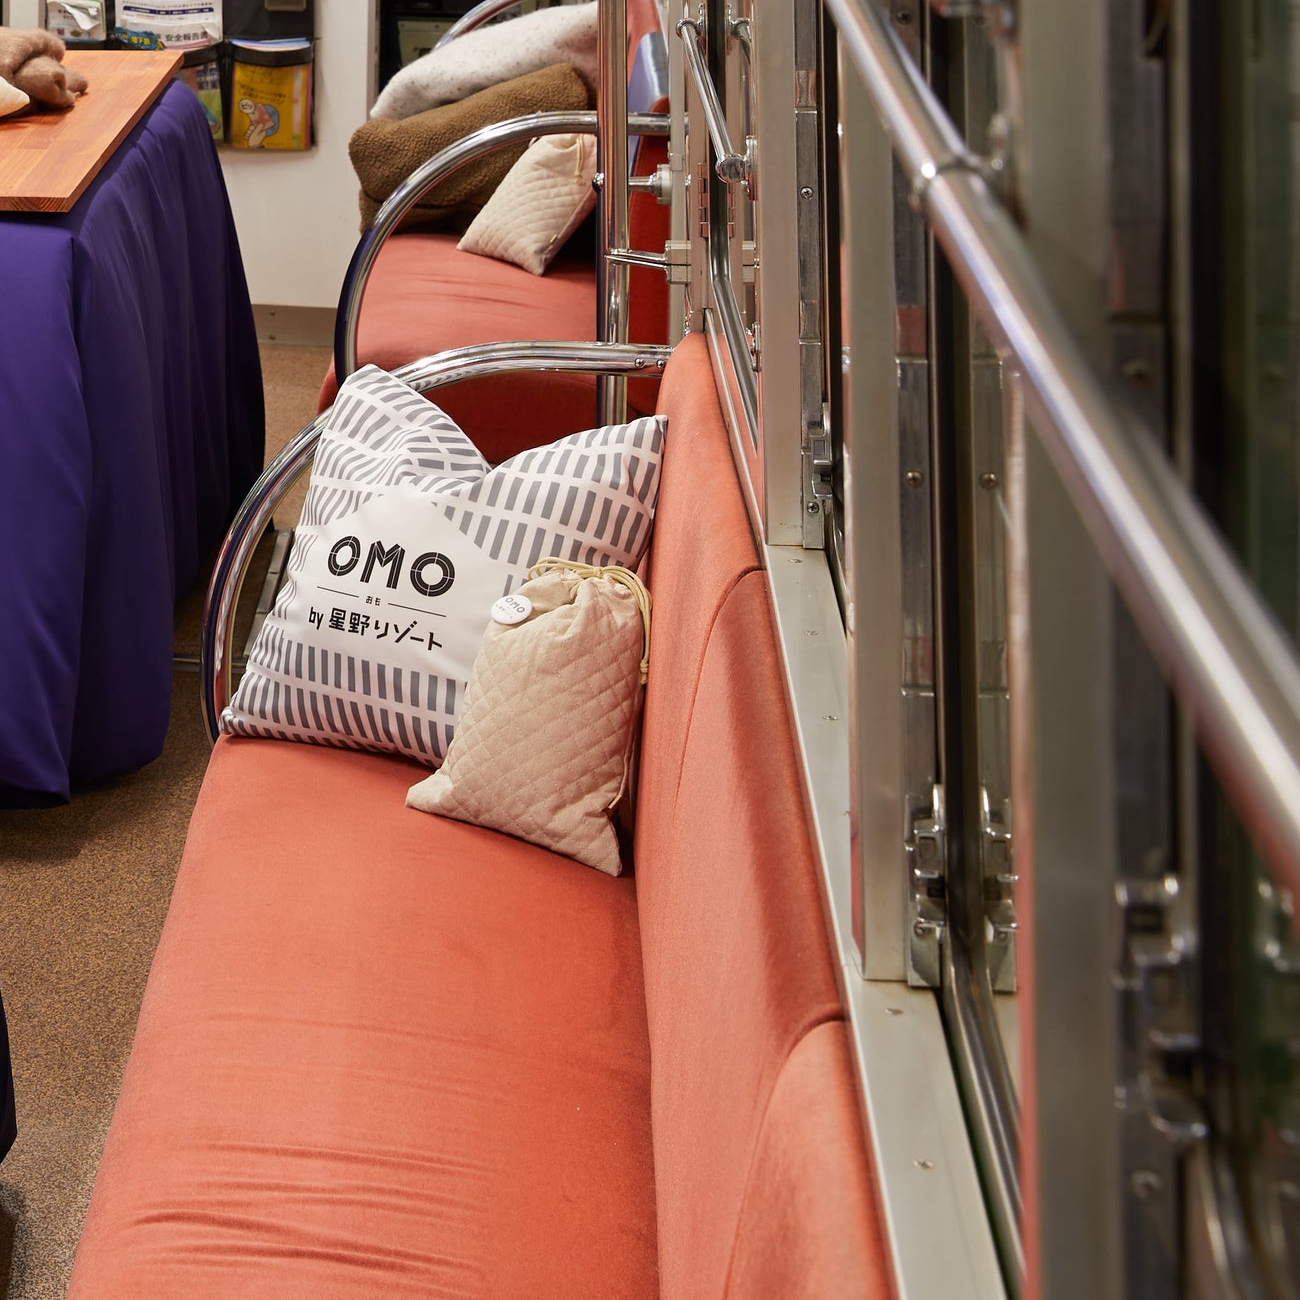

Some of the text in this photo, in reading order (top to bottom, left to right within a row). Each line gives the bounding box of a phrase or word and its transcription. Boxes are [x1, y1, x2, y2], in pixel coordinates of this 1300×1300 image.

[327, 535, 456, 597] OMO
[365, 595, 381, 606] おも
[505, 597, 526, 613] OMO
[308, 606, 444, 651] by 星野リゾート
